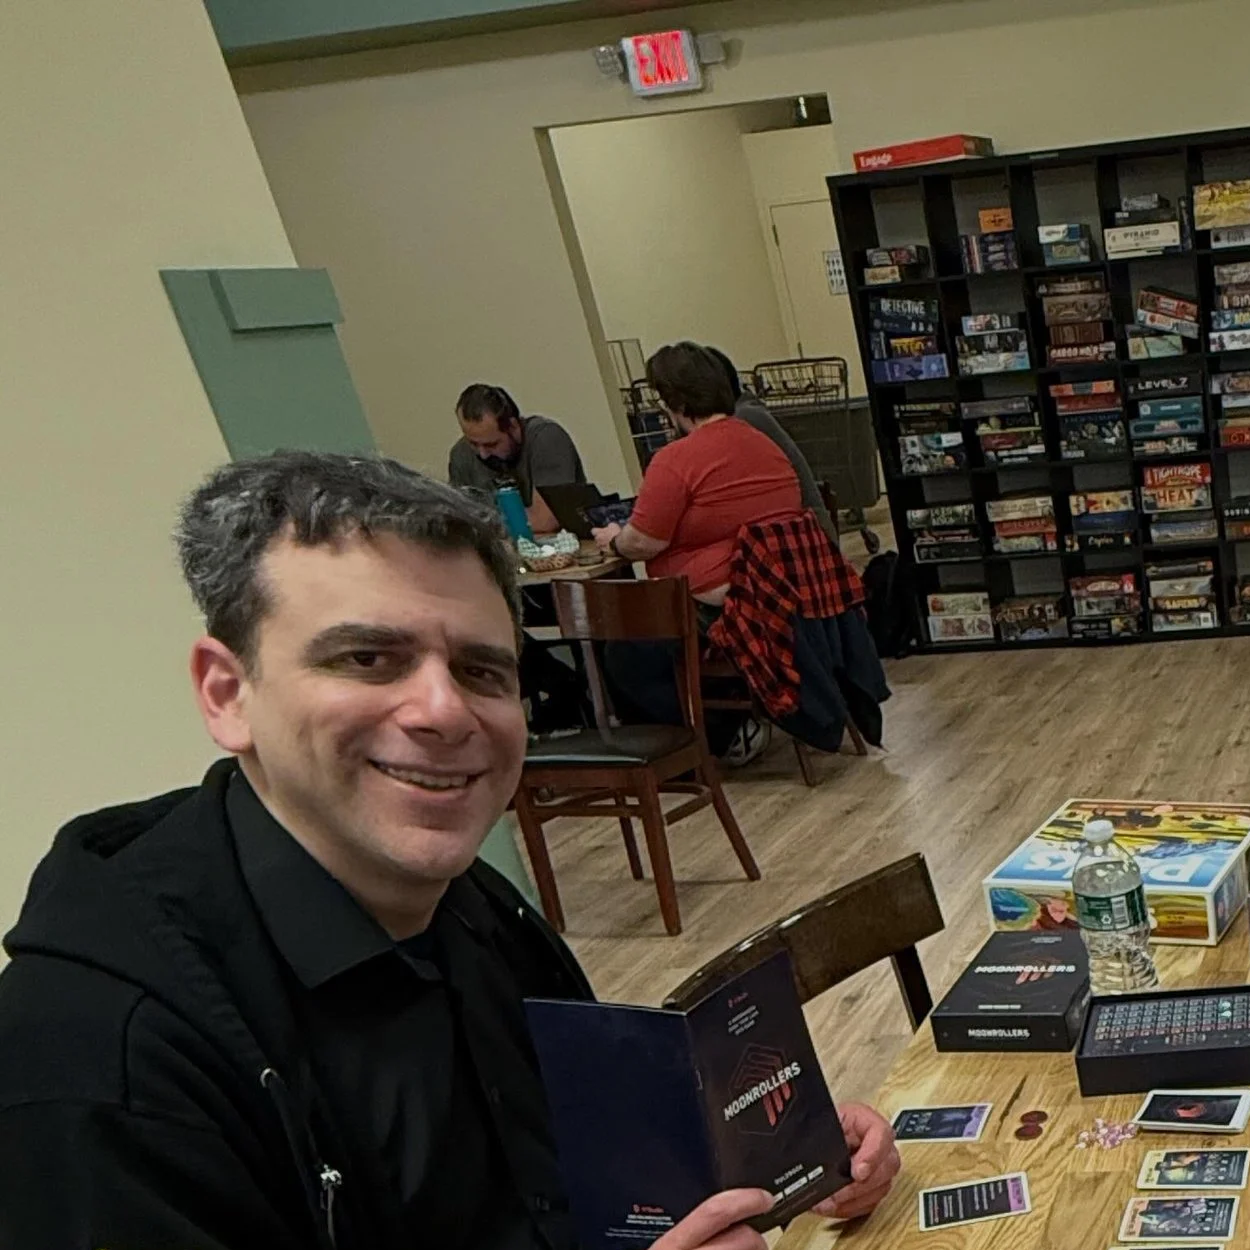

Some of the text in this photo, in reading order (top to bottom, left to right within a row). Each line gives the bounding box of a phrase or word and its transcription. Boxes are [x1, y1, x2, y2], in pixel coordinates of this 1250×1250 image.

[1157, 488, 1194, 502] HEAT
[968, 1028, 1031, 1039] MOONROLLERS
[723, 1062, 801, 1121] MOONROLLERS
